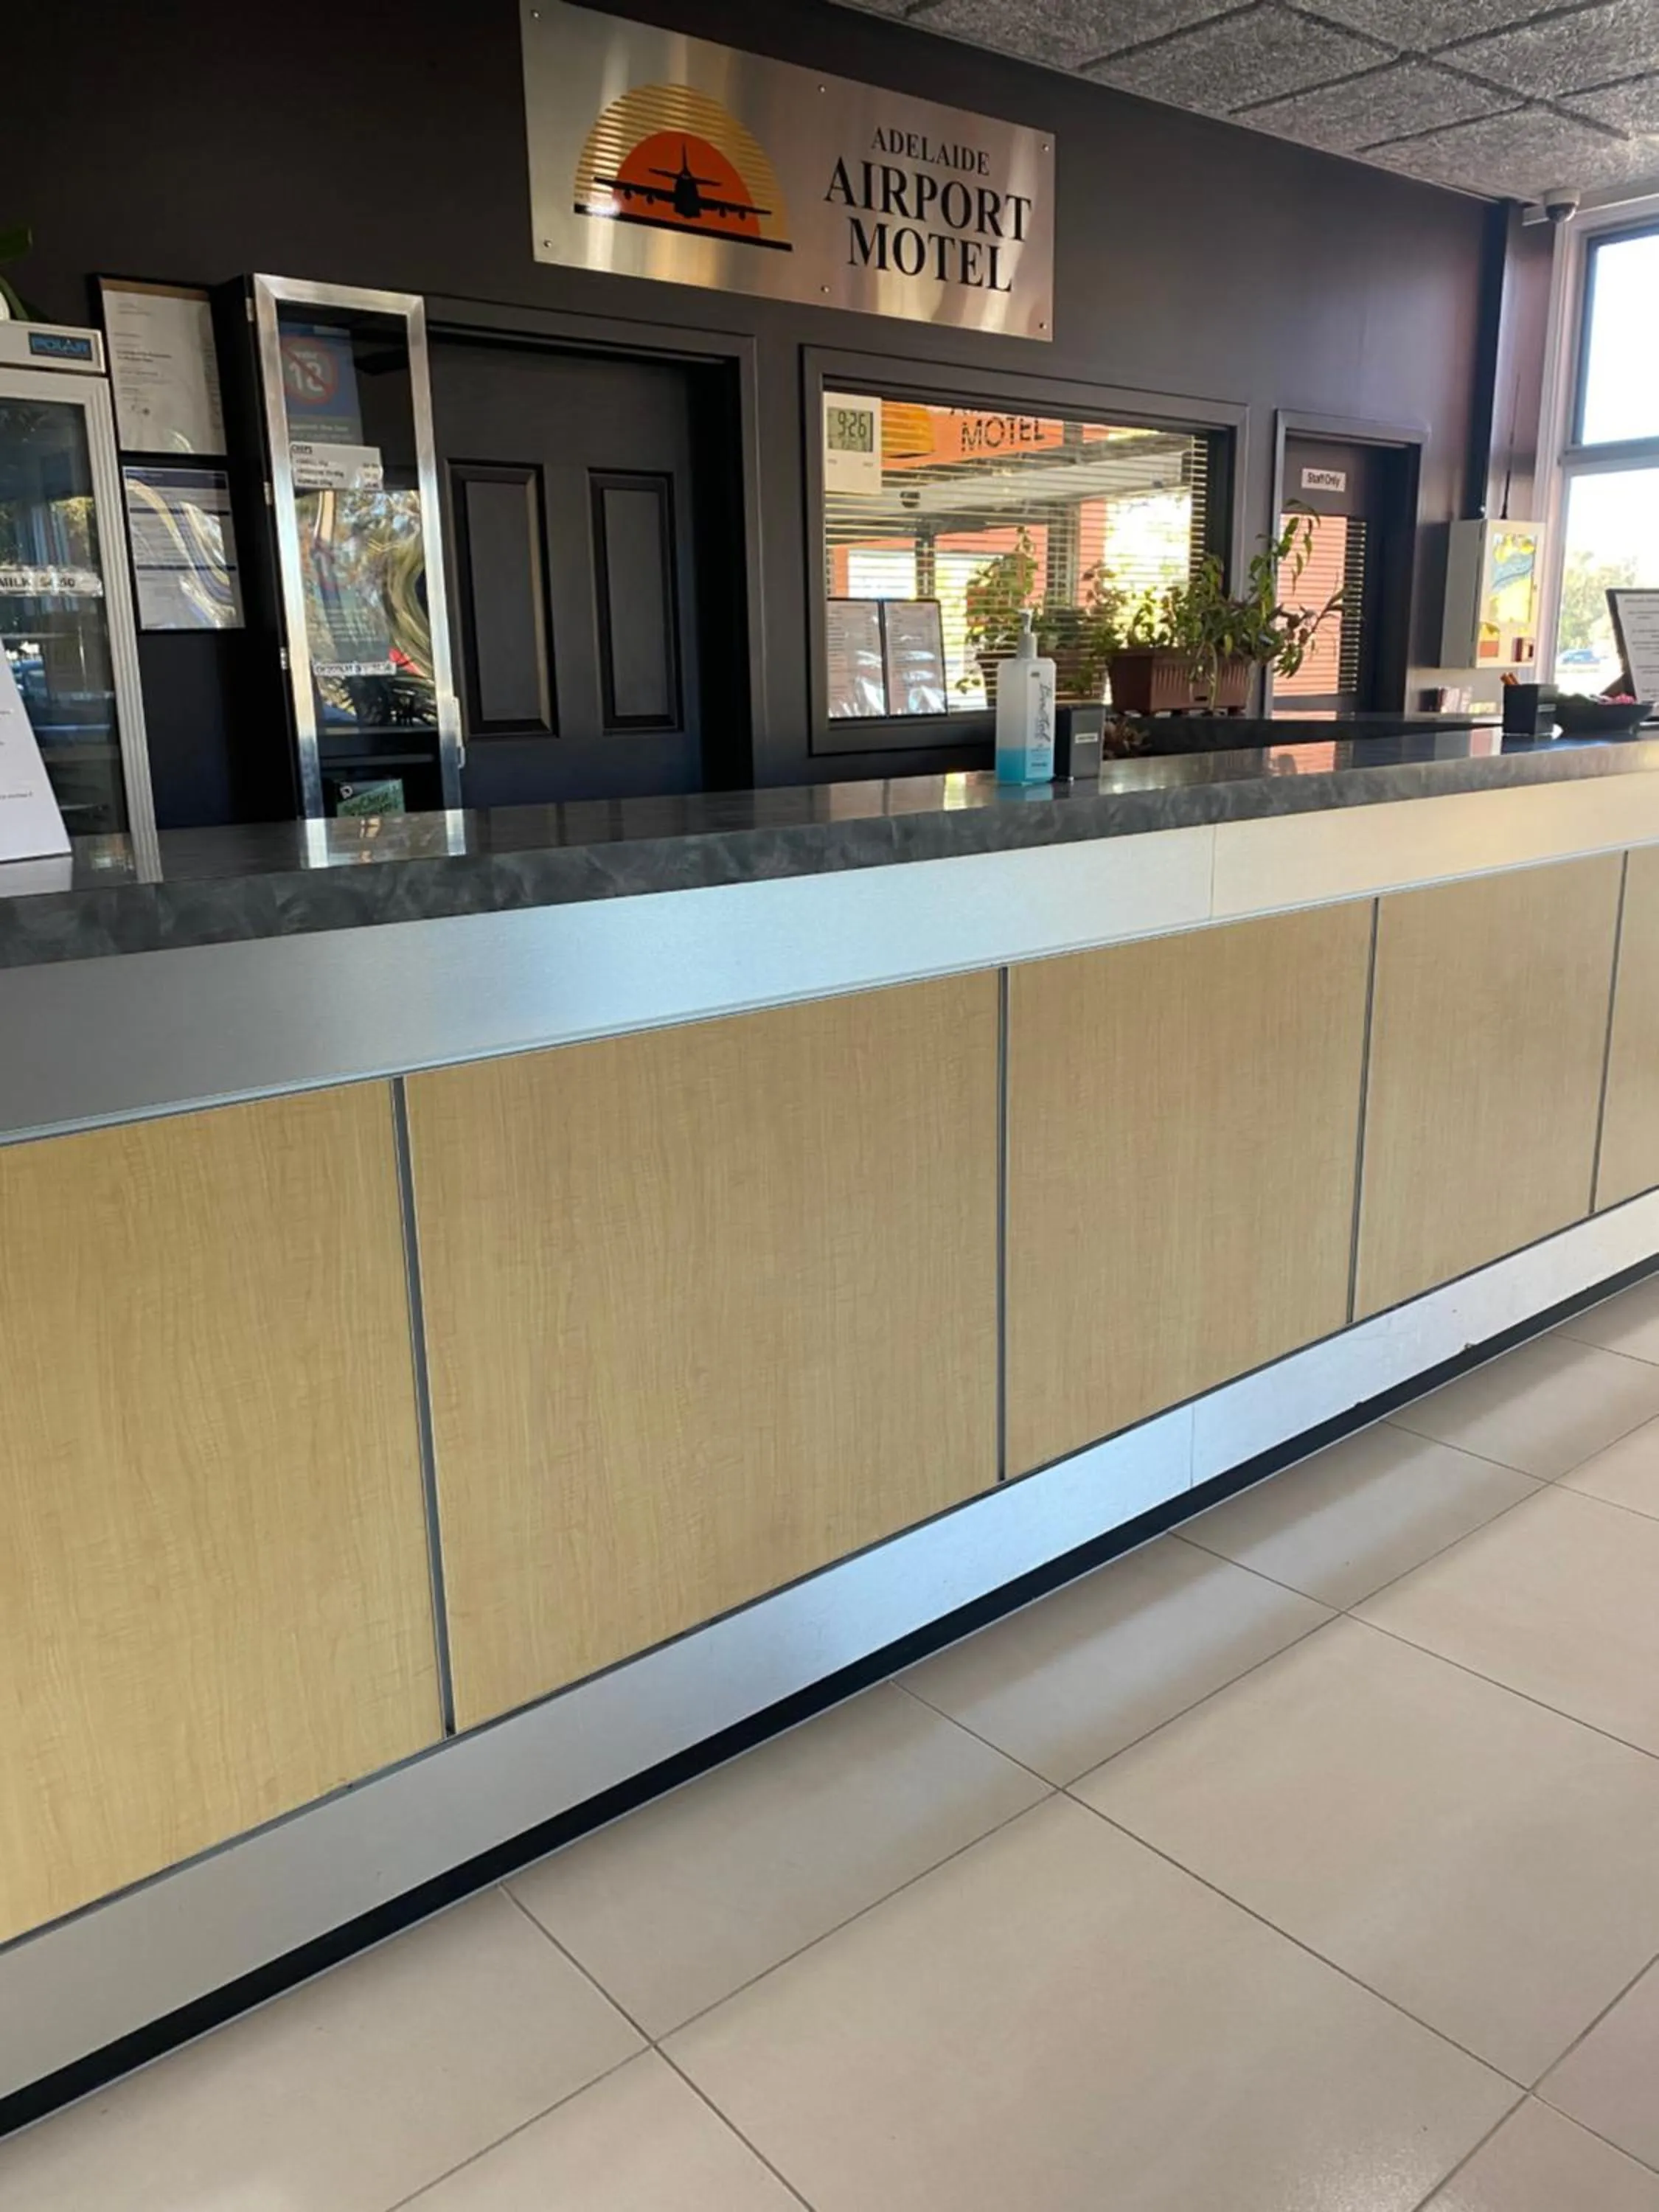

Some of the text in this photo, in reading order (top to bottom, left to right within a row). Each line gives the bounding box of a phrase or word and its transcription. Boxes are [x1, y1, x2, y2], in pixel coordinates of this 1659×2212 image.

[871, 126, 990, 176] ADELAIDE
[823, 156, 1032, 243] AIRPORT
[847, 216, 1012, 292] MOTEL
[961, 415, 1046, 452] MOTEL
